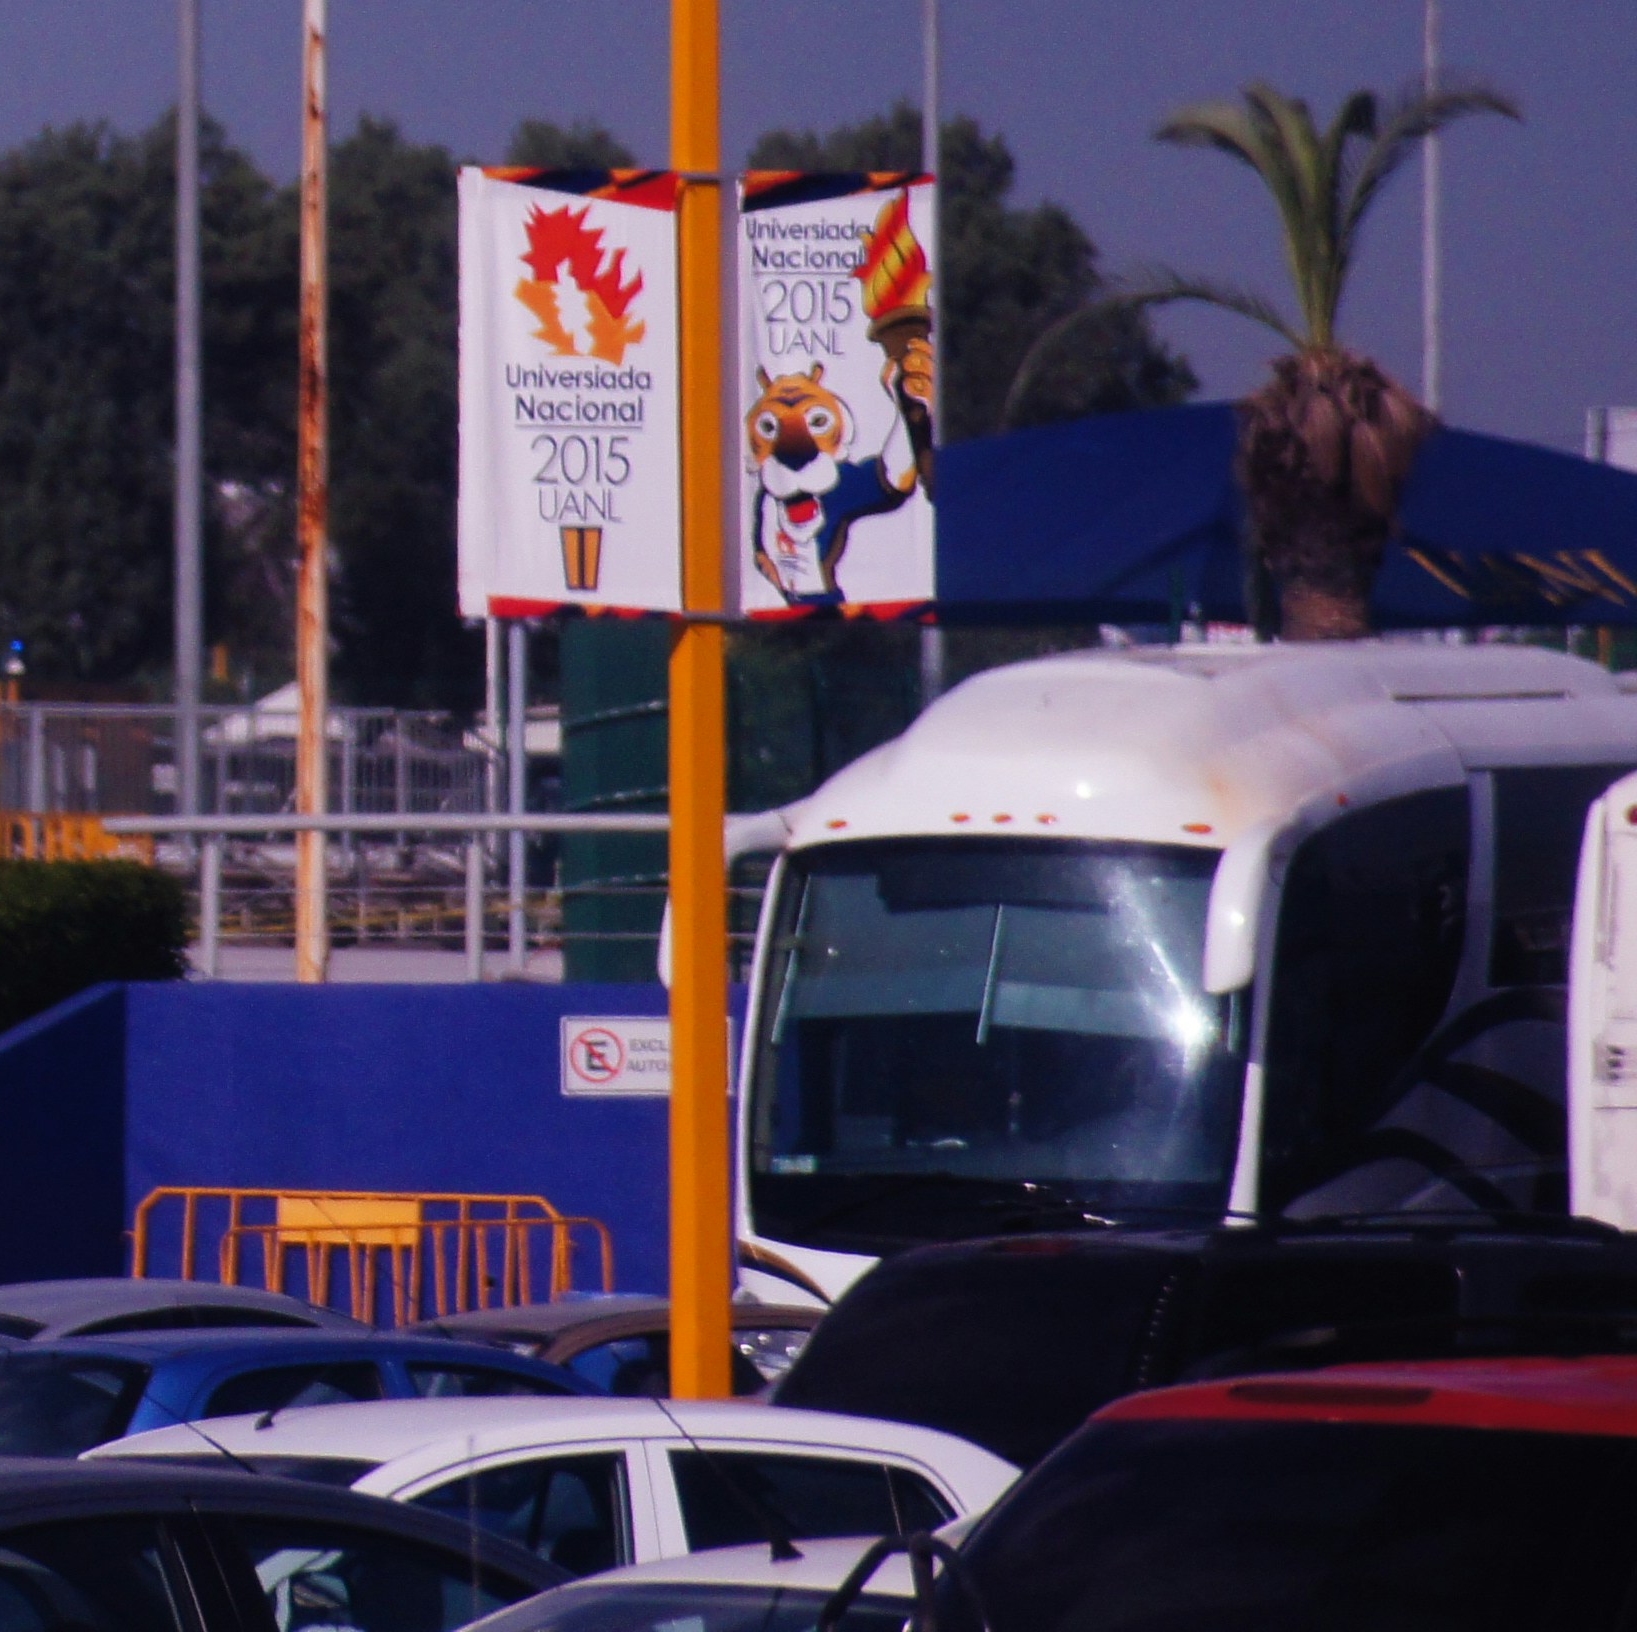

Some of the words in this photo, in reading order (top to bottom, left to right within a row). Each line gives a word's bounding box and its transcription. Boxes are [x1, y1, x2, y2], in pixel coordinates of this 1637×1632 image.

[752, 244, 863, 269] Nacional
[762, 279, 853, 324] 2015
[768, 326, 845, 356] UANL
[506, 365, 652, 391] Universiada
[516, 395, 644, 423] Nacional
[531, 434, 631, 486] 2015
[538, 489, 623, 523] UANL
